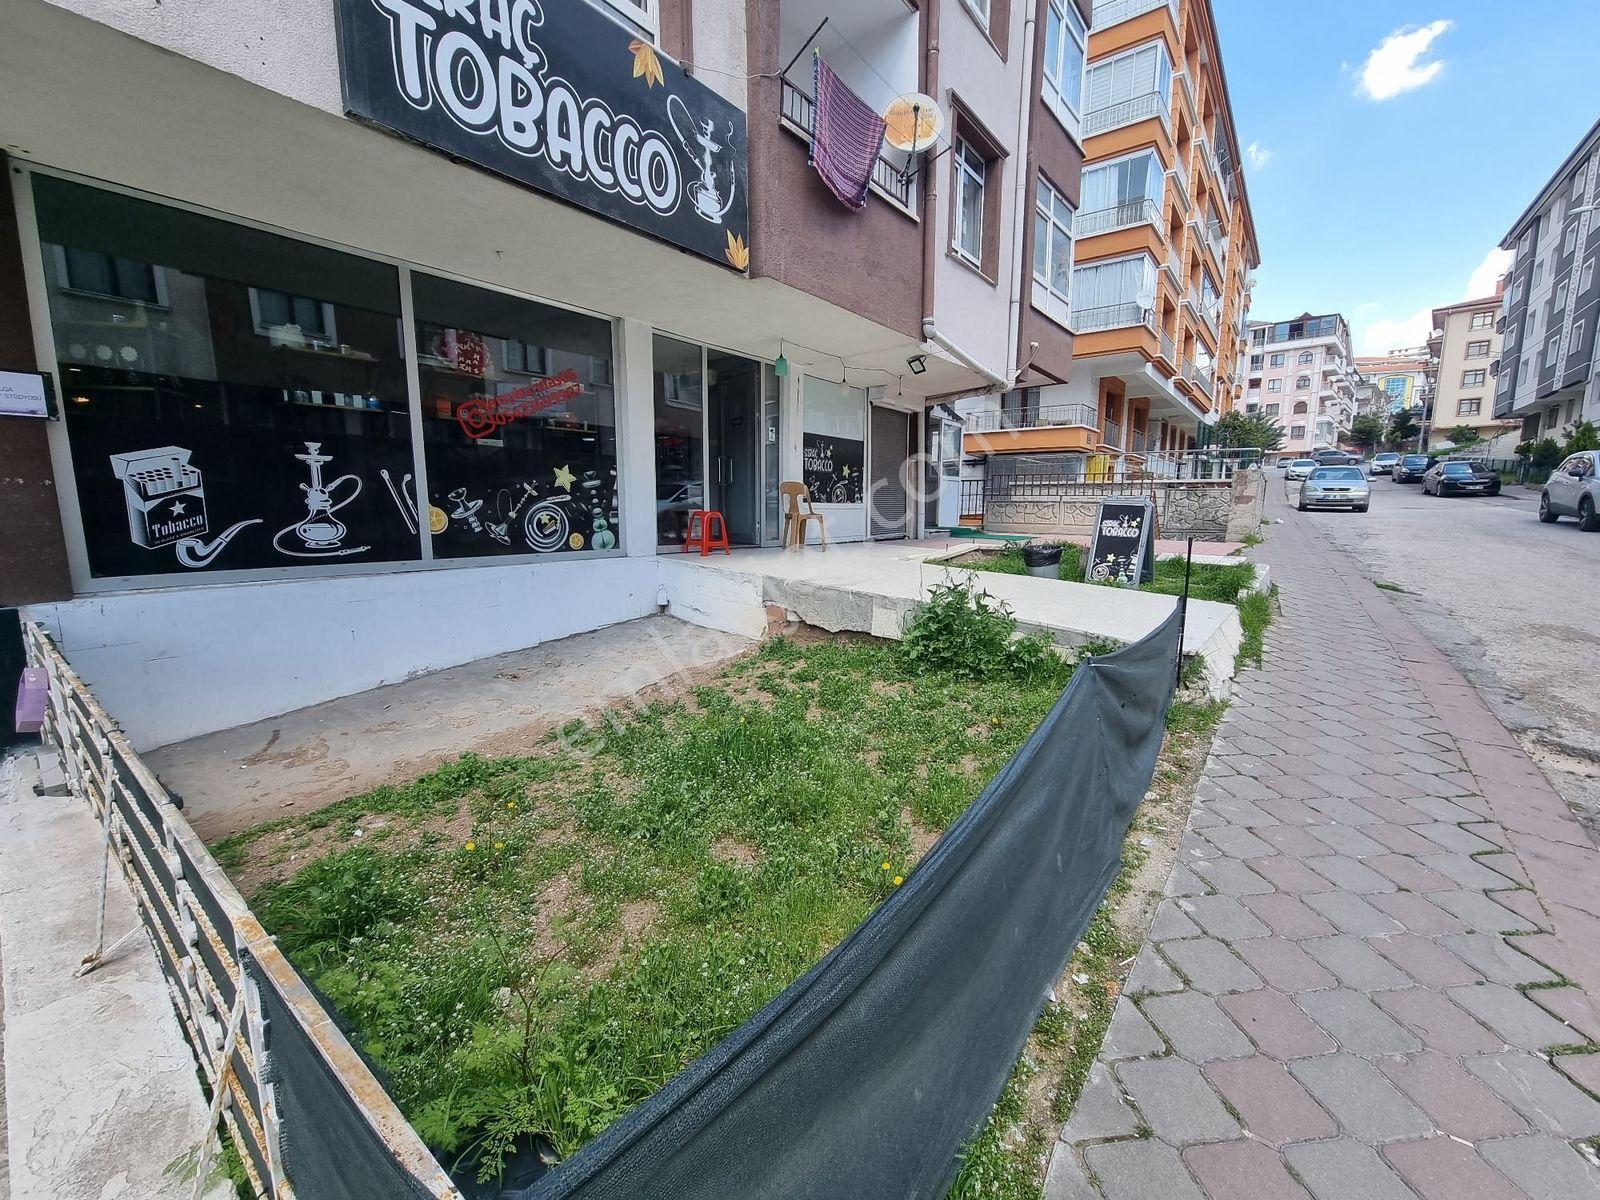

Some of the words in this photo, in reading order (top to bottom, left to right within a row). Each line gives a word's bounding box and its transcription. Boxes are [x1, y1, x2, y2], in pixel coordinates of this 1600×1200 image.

[378, 0, 678, 210] TOBACCO
[804, 457, 833, 472] TOBACCO
[152, 515, 203, 538] Tobacco
[1101, 526, 1140, 538] TOBACCO
